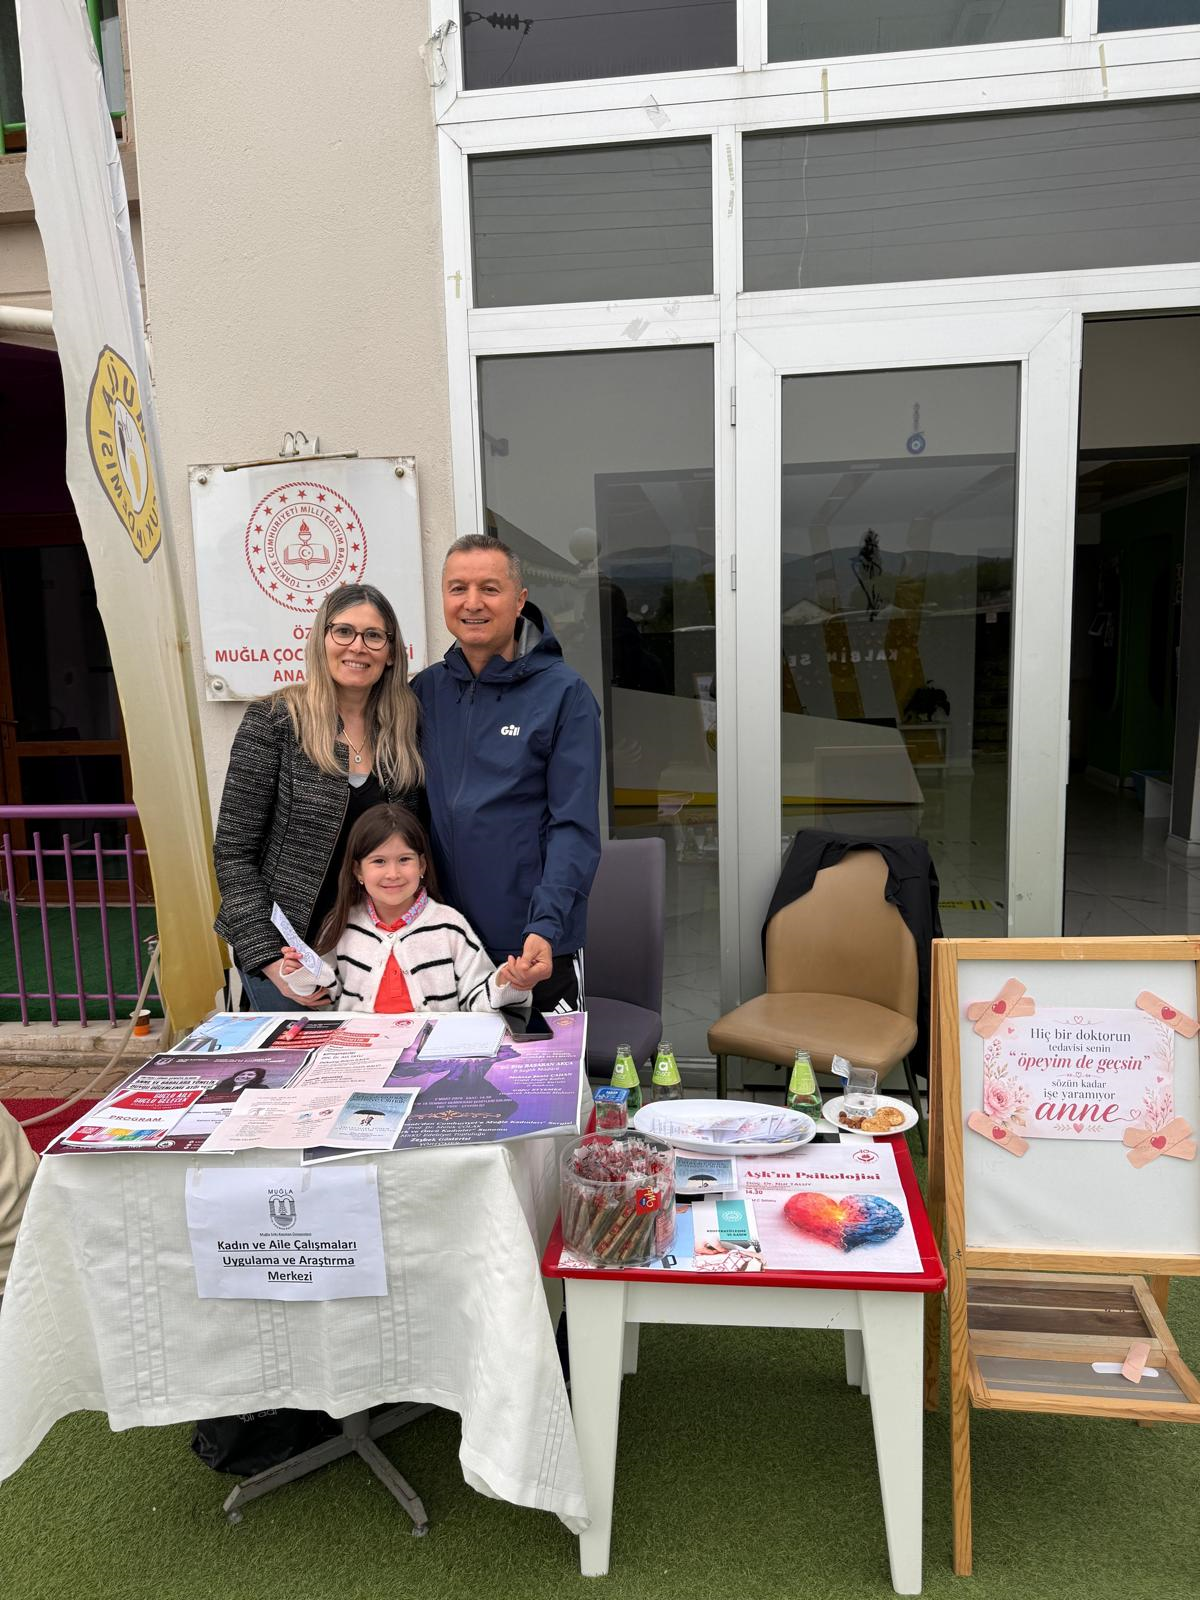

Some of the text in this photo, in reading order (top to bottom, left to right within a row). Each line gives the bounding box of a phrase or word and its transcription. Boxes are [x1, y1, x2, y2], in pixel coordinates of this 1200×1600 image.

[266, 505, 345, 588] TÜRKİYE CUMHURİYETİ MİLLİ EĞİTİM BAKANLIĞI
[292, 624, 312, 640] ÖZ
[215, 646, 304, 664] MUĞLA ÇOC
[273, 669, 306, 682] ANA
[500, 724, 521, 736] Gill
[1030, 1027, 1131, 1042] Hiç bir doktorun
[1048, 1043, 1111, 1053] tedavisi senin
[1075, 1055, 1093, 1069] de
[1051, 1079, 1107, 1089] sözün kadar
[1043, 1089, 1116, 1102] işe yaramıyor
[1035, 1101, 1122, 1123] anne
[217, 1239, 357, 1252] Kadın ve Aile Çalışmaları
[223, 1256, 355, 1268] Uygulama ve Araştırma
[267, 1270, 313, 1282] Merkezi
